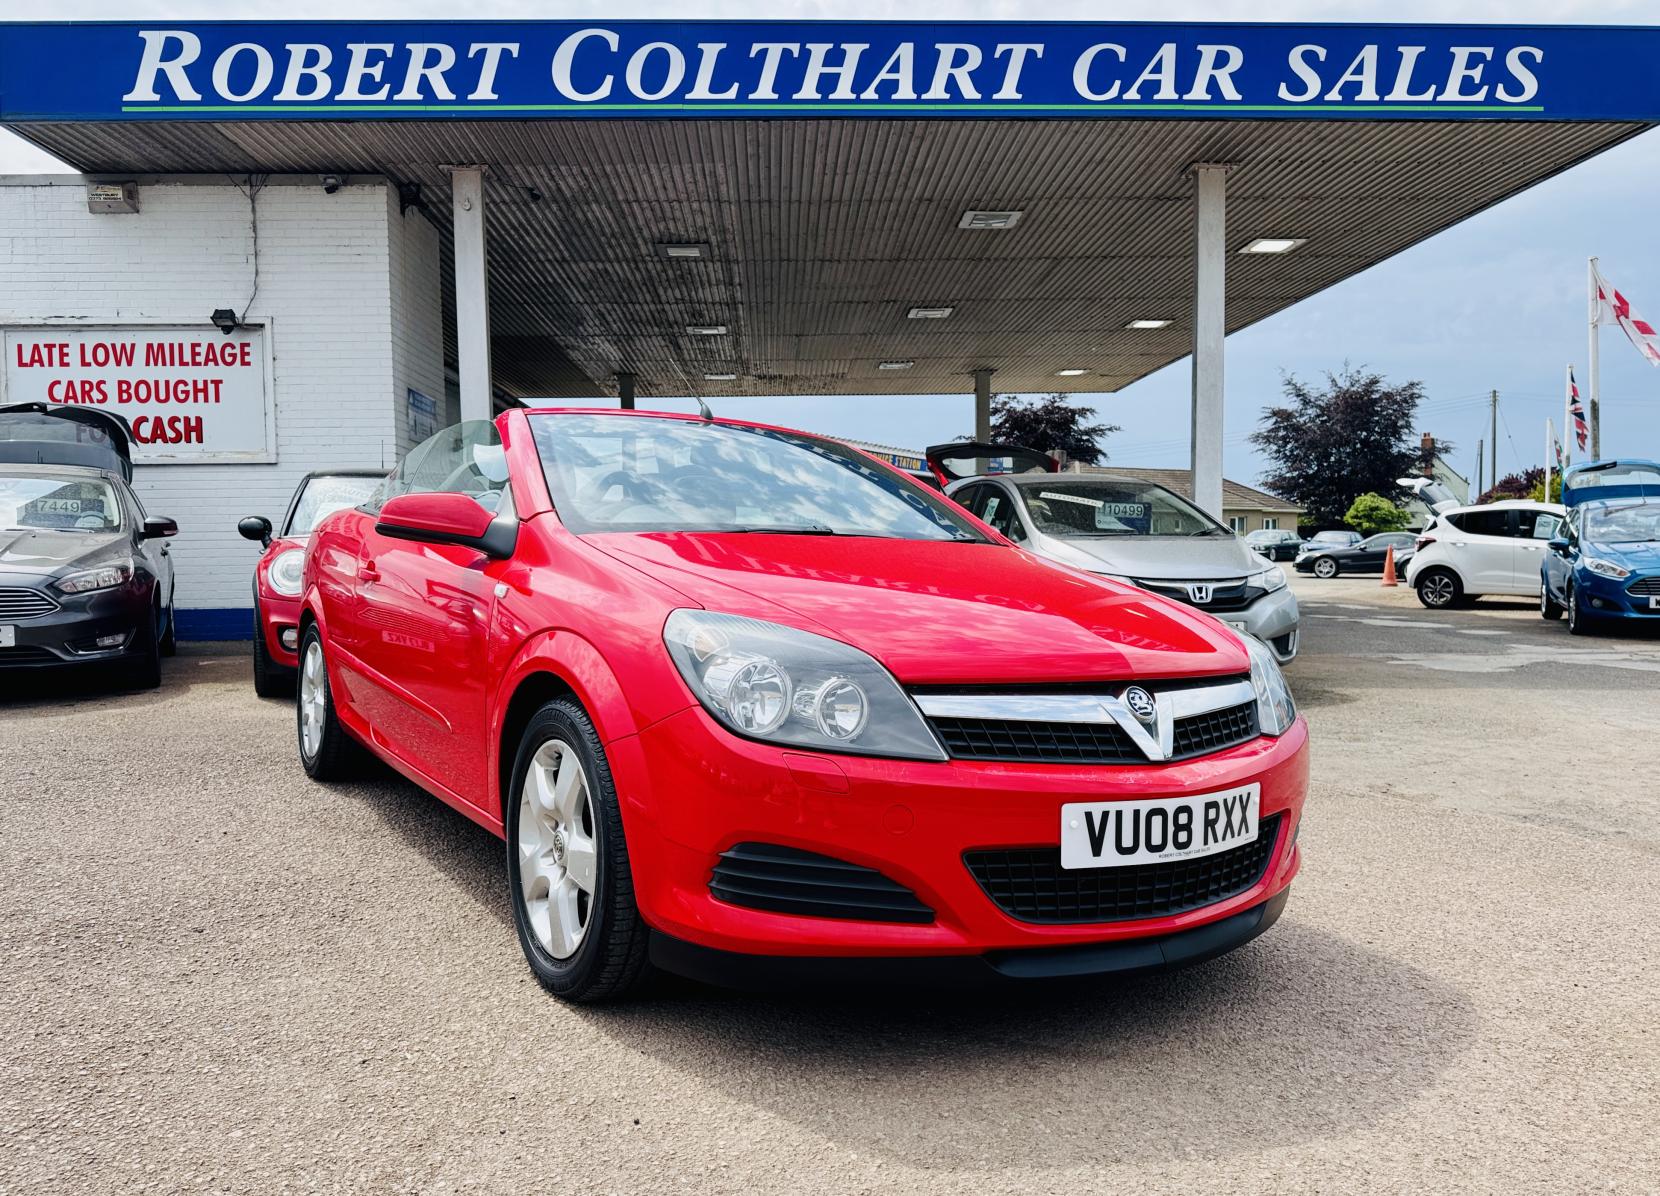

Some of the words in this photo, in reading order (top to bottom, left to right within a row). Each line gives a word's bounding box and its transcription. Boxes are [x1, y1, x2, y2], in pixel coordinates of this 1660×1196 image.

[122, 30, 520, 102] ROBERT
[551, 28, 1045, 102] COLTHART
[1072, 43, 1244, 102] CAR
[1277, 44, 1545, 103] SALES
[16, 342, 71, 368] LATE
[79, 342, 136, 368] LOW
[145, 342, 252, 367] MILEAGE
[47, 379, 109, 404] CARS
[116, 378, 224, 404] BOUGHT
[132, 415, 204, 444] CASH
[895, 455, 921, 470] STATION
[38, 500, 80, 513] 7449
[1108, 504, 1143, 517] 10499
[1084, 804, 1194, 858] VU08
[1203, 791, 1251, 846] RXX
